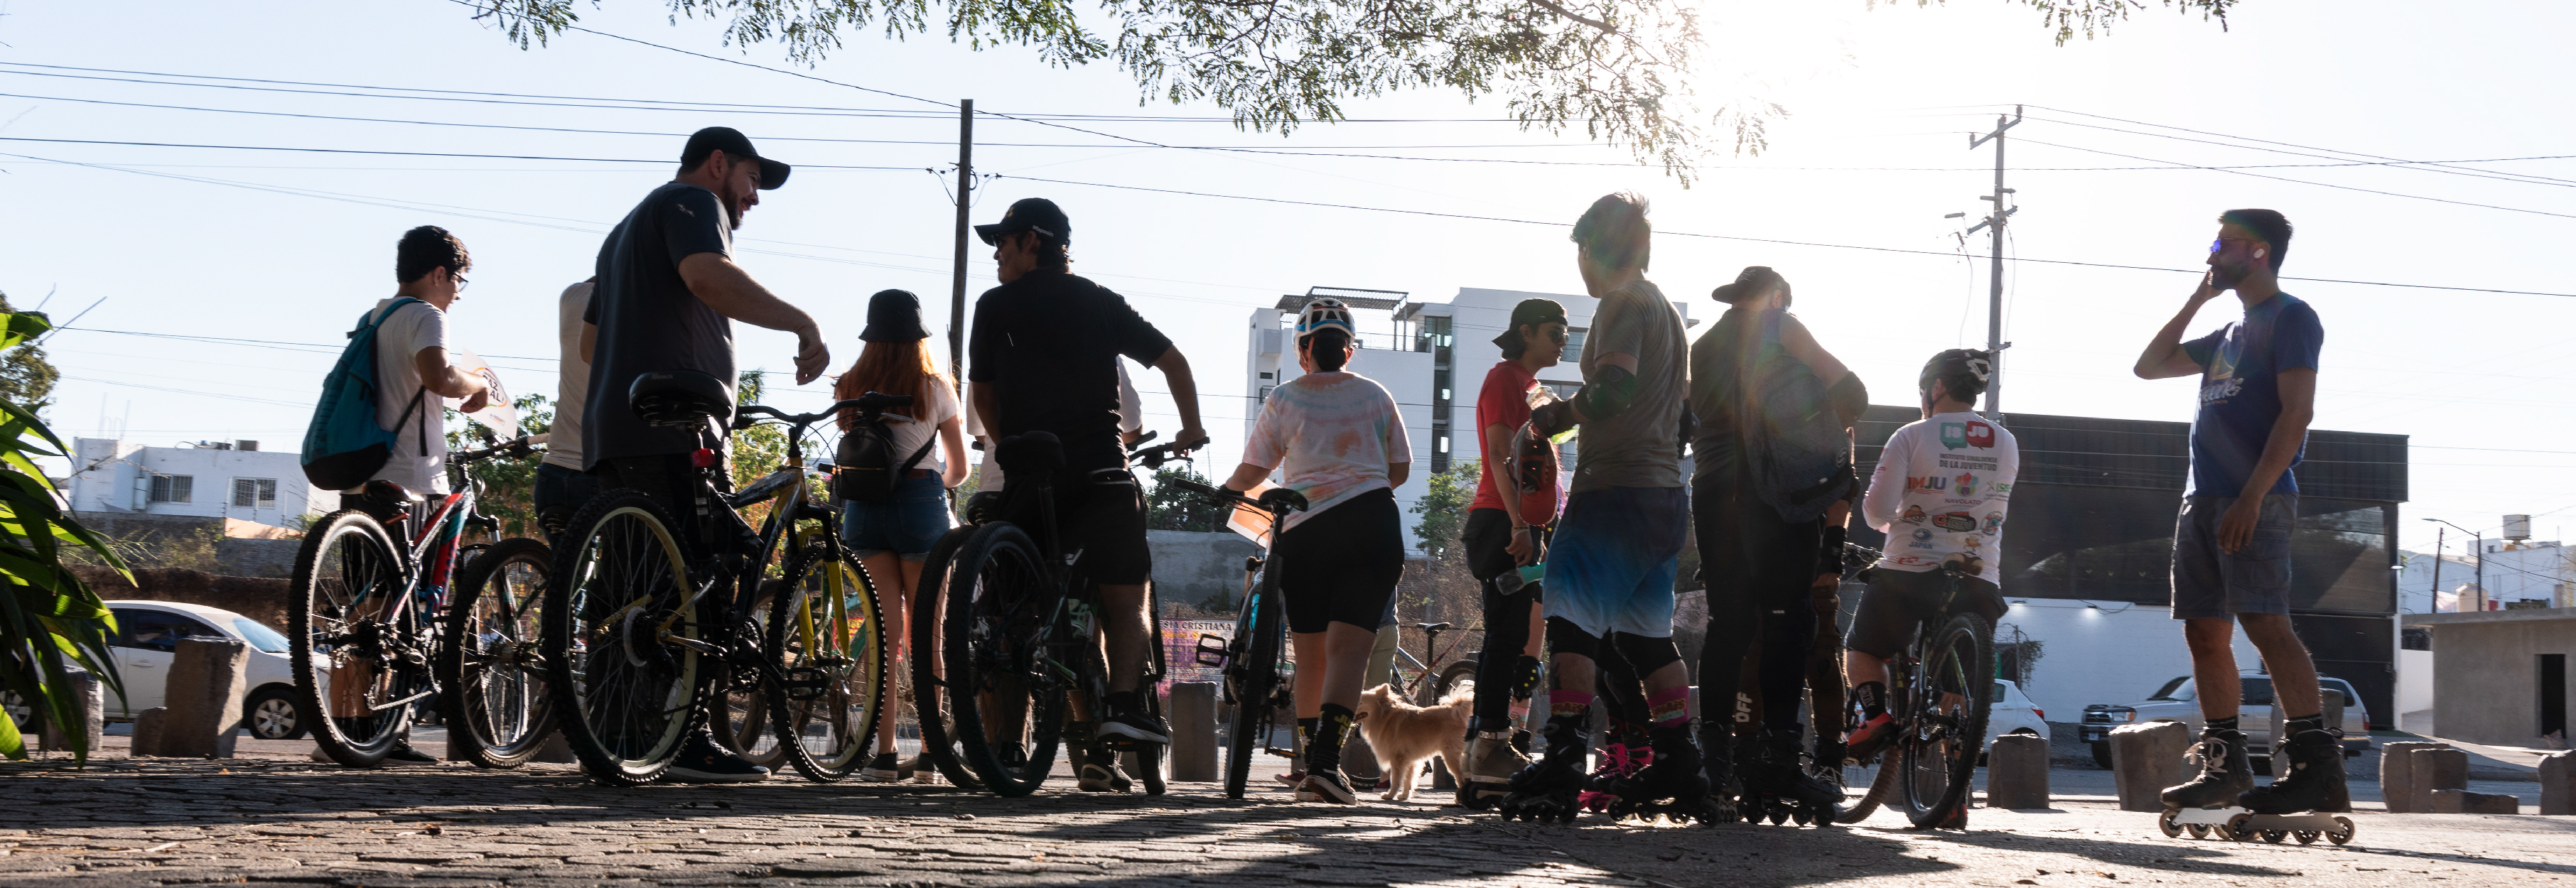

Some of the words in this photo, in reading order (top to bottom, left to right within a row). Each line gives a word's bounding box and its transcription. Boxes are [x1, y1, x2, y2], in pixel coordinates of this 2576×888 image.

[1944, 426, 1963, 438] IS
[1967, 426, 1989, 438] JU
[1950, 460, 1958, 469] LA
[1960, 461, 1998, 471] JUVENTUD
[1182, 621, 1232, 631] CRISTIANA
